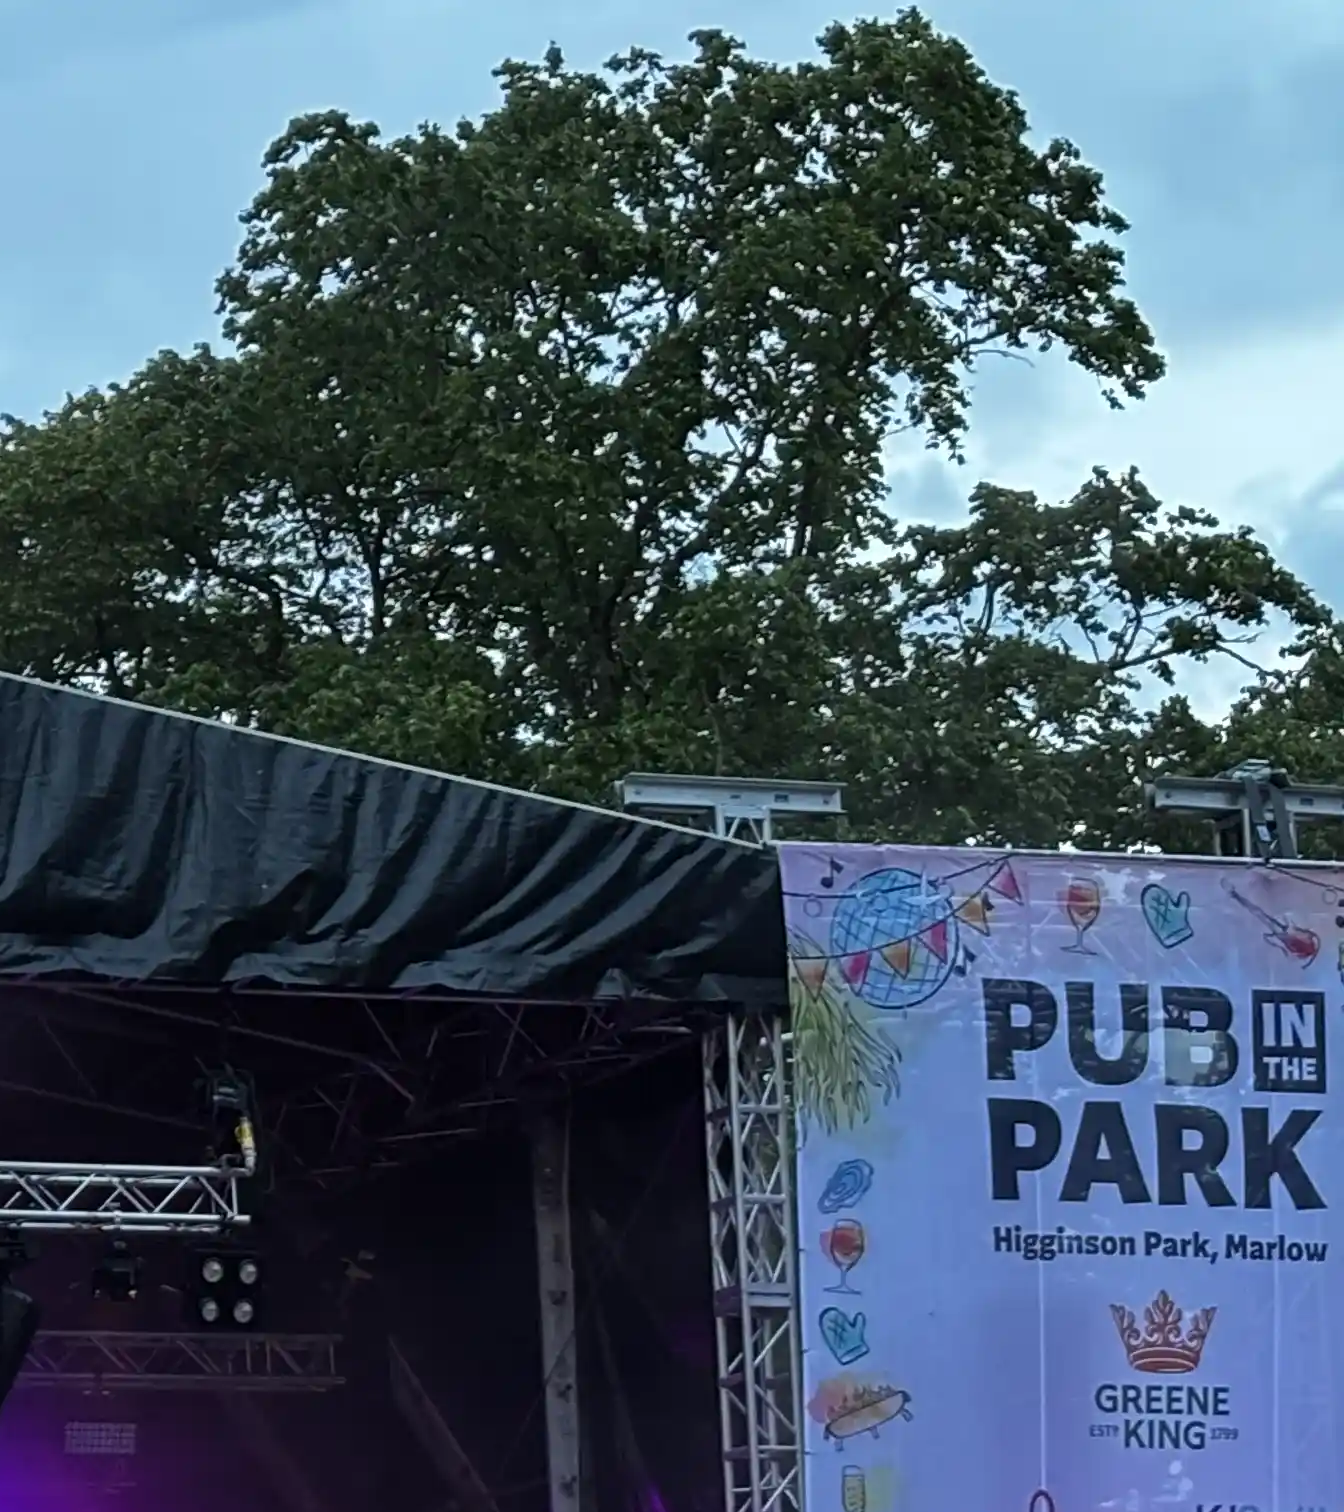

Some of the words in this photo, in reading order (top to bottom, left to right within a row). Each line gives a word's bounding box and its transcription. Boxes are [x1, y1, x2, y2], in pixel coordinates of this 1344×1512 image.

[982, 978, 1239, 1087] PUB
[1262, 1003, 1316, 1048] IN
[1263, 1057, 1317, 1081] THE
[987, 1098, 1328, 1210] PARK
[993, 1225, 1136, 1260] Higginson
[1144, 1231, 1218, 1264] Park,
[1225, 1233, 1328, 1262] Marlow
[1094, 1383, 1230, 1416] GREENE
[1124, 1419, 1206, 1450] KING
